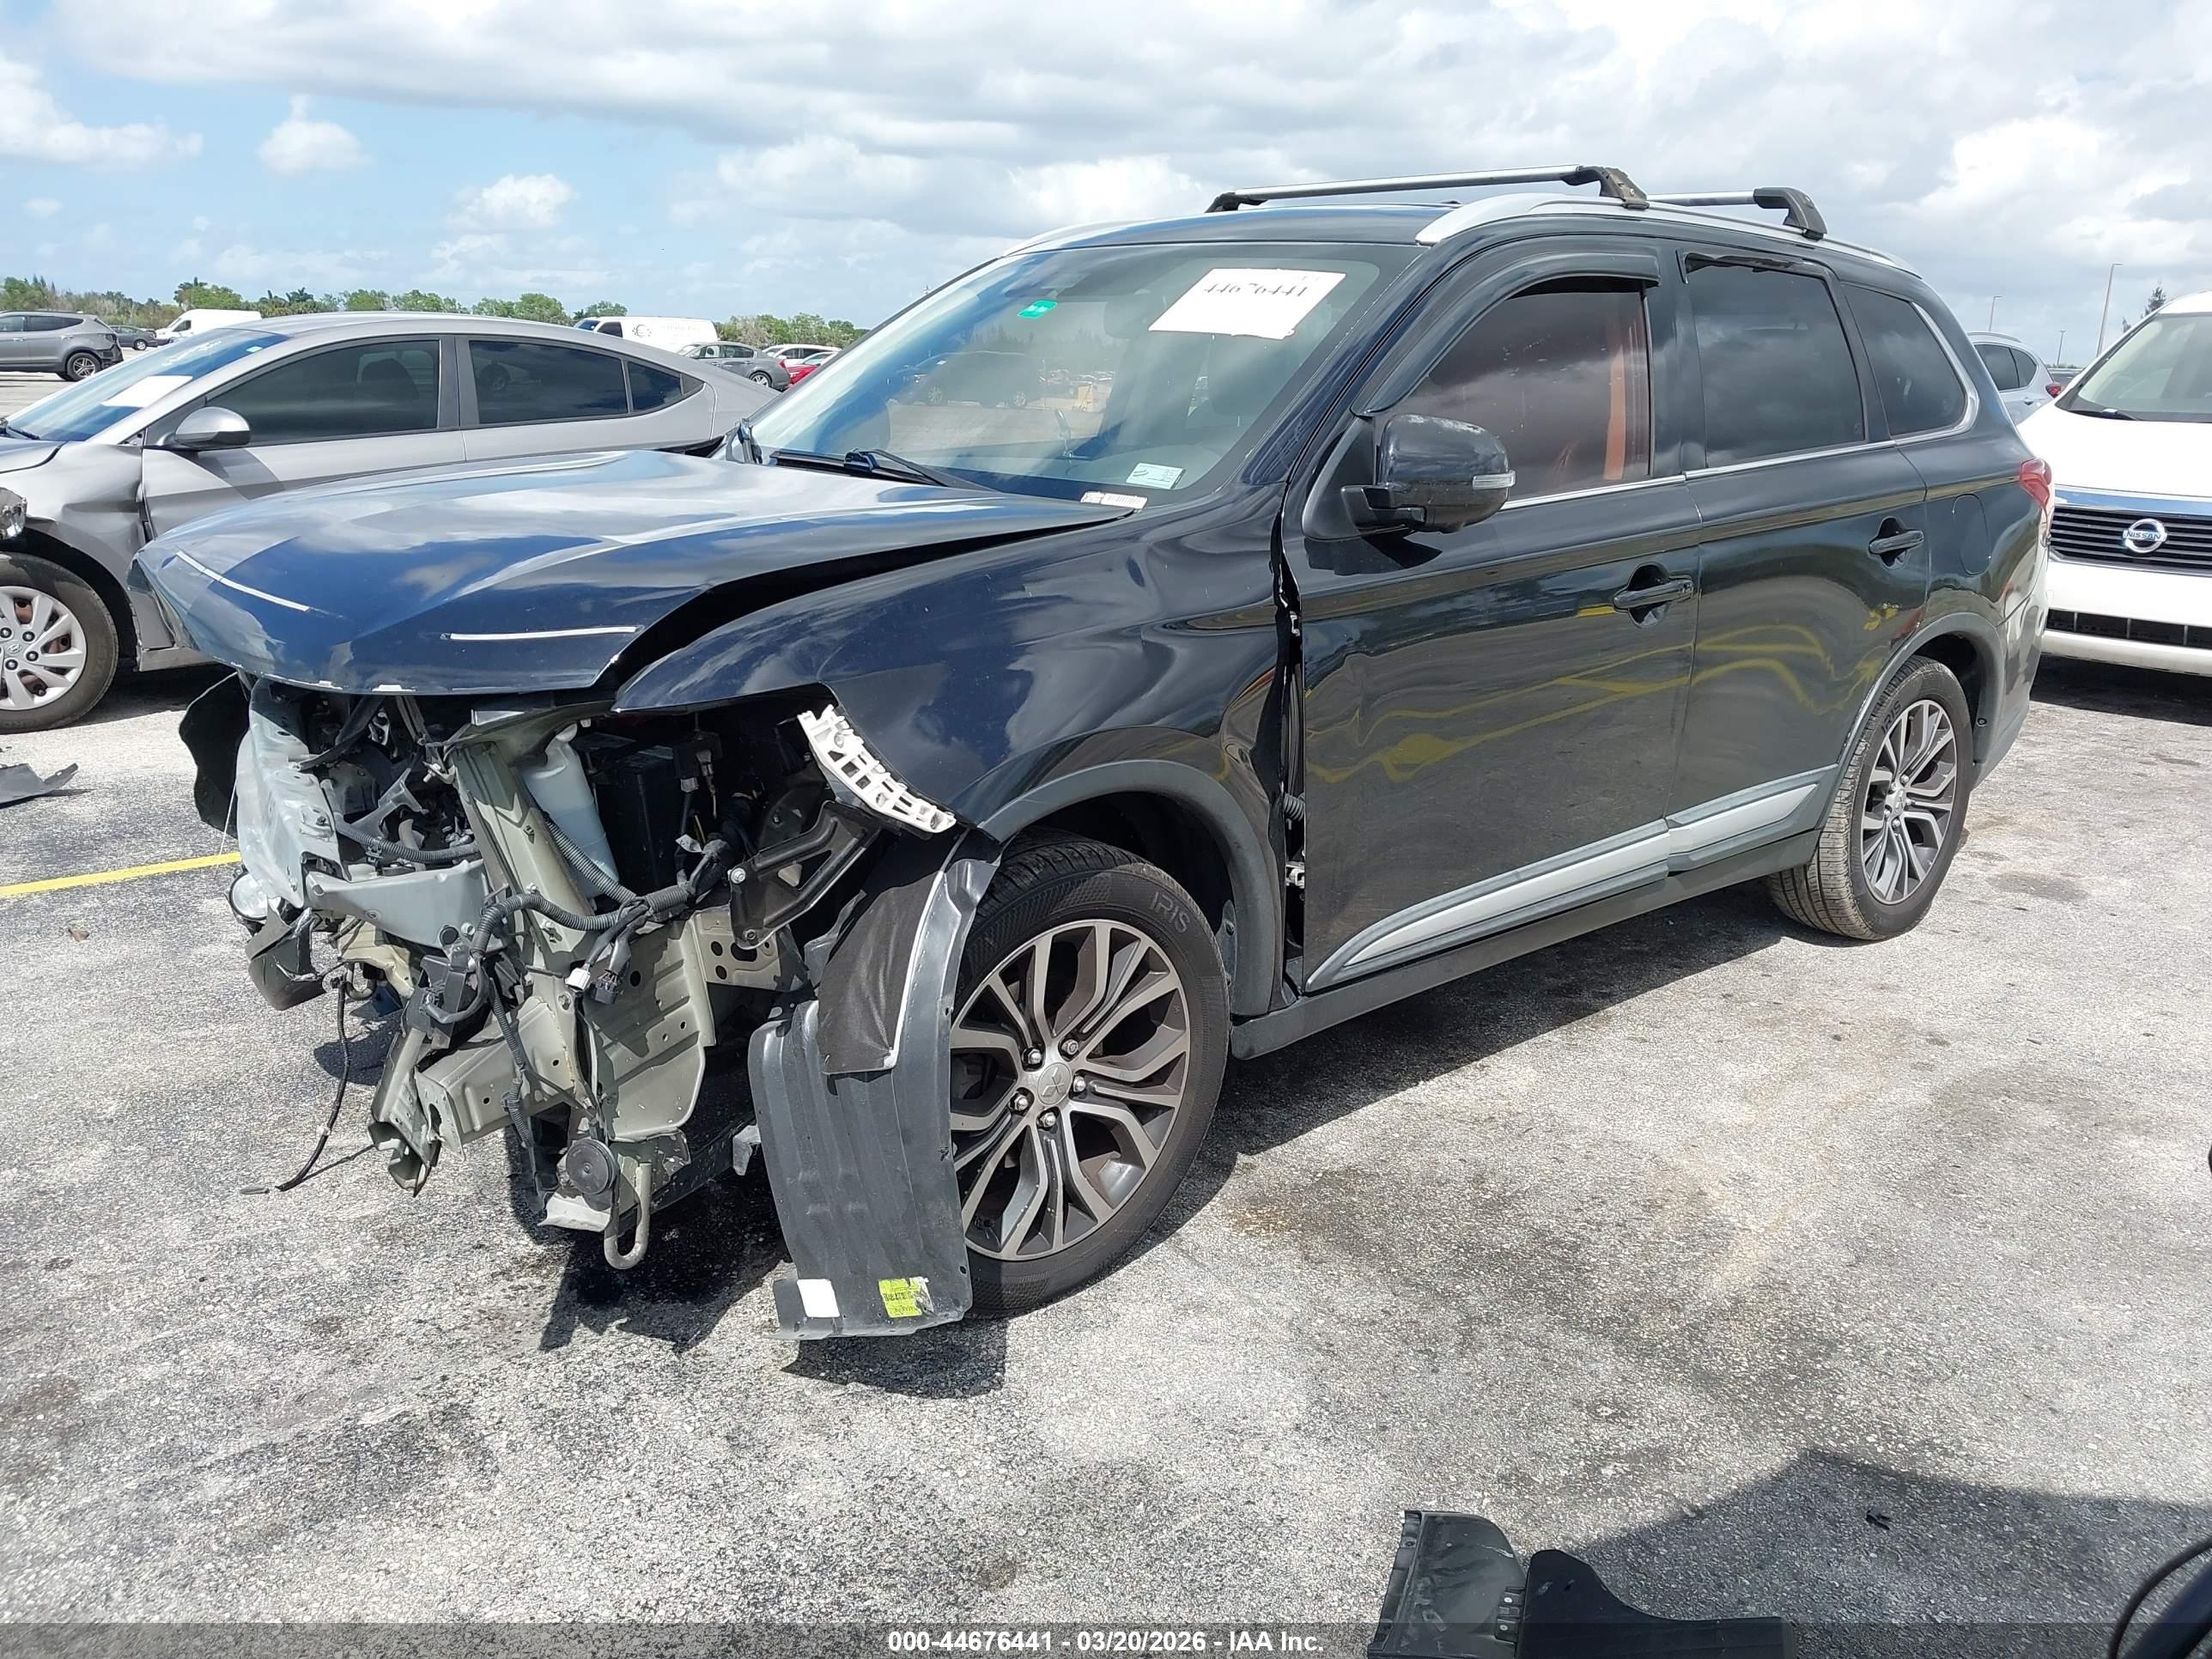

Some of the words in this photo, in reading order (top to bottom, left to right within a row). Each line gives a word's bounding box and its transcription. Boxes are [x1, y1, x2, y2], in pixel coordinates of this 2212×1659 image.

[1203, 283, 1308, 297] 4466441
[2126, 530, 2162, 540] NISSAN
[1880, 700, 1902, 734] IRIS
[1150, 891, 1190, 933] IRIS
